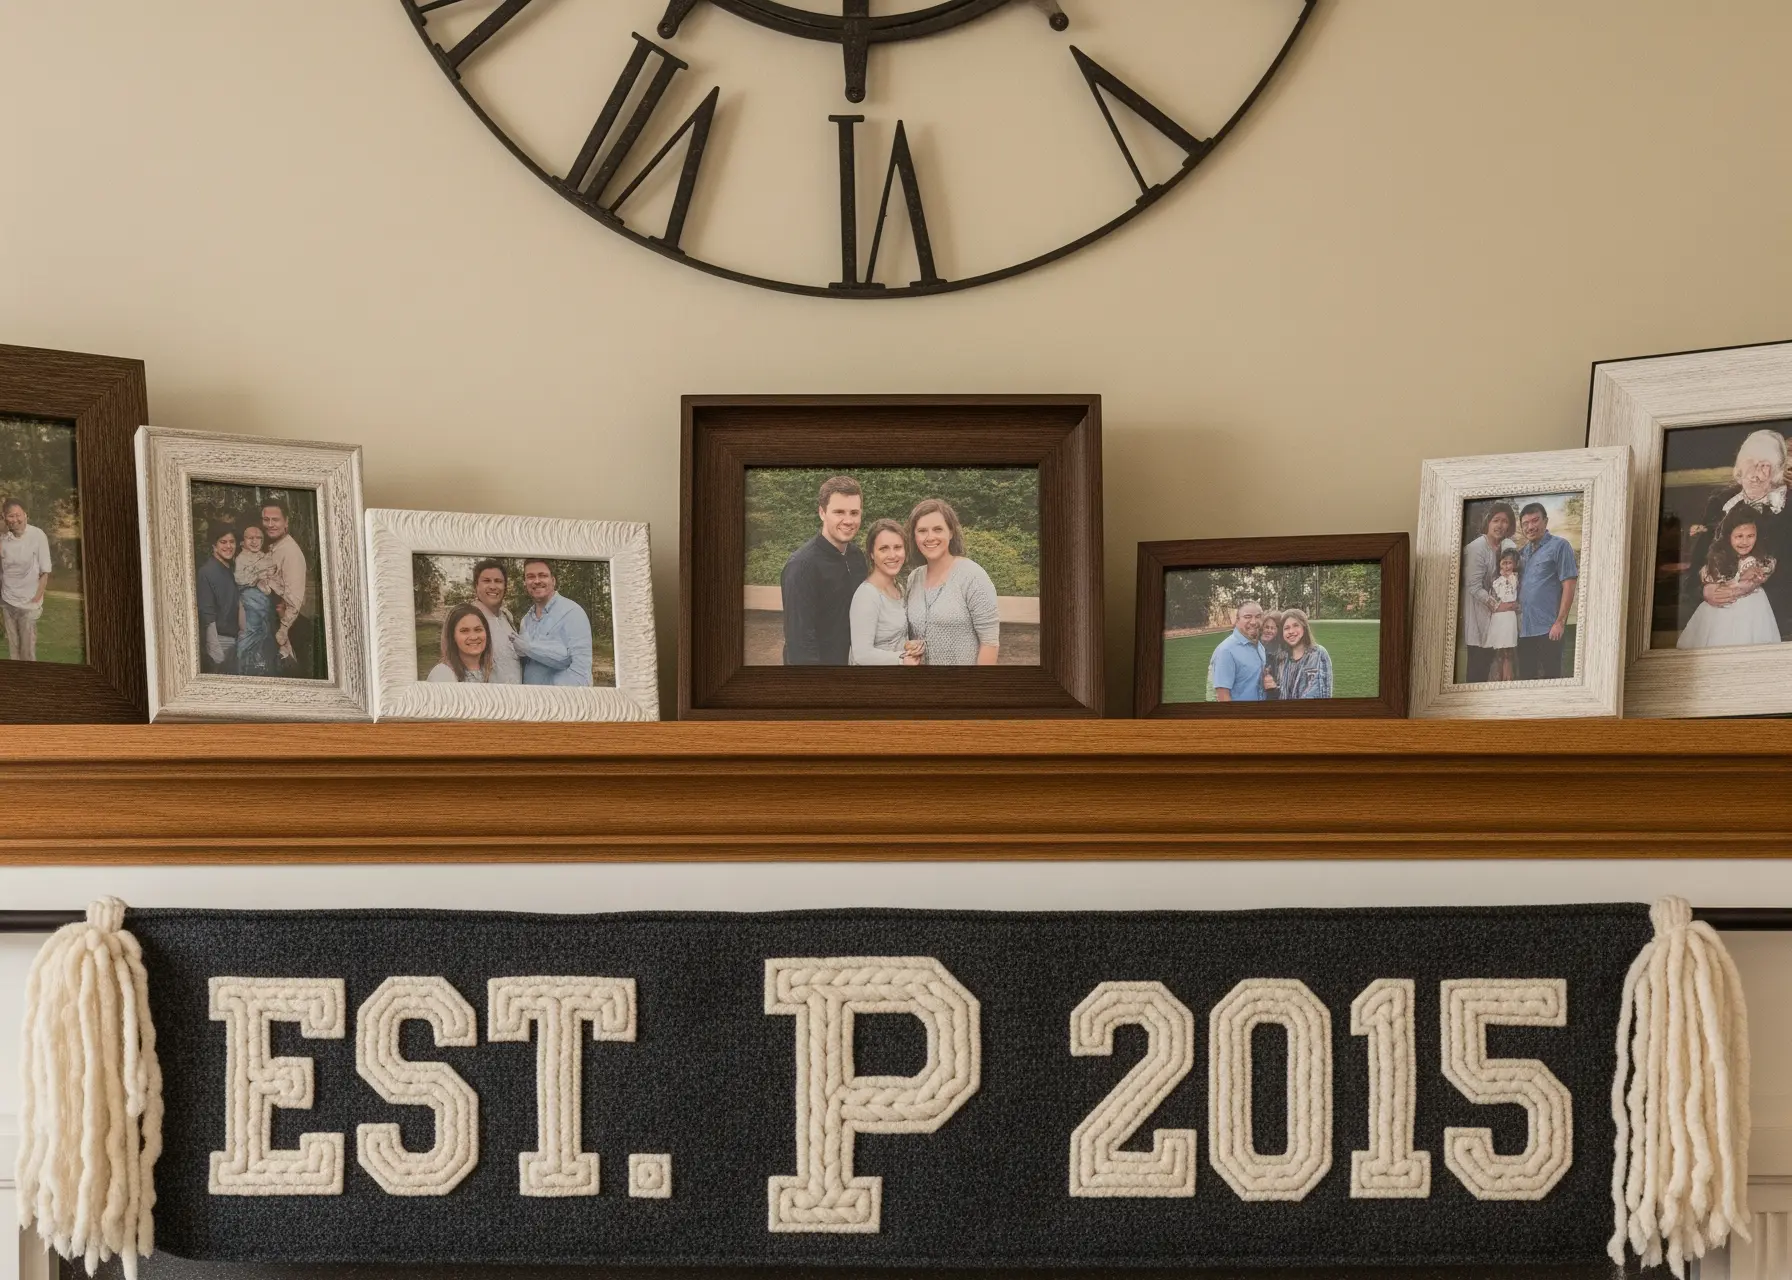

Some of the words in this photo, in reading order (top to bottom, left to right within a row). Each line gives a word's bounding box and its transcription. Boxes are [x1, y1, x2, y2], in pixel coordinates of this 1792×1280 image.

[207, 975, 672, 1198] EST.
[764, 956, 981, 1234] P
[1069, 978, 1573, 1202] 2015
